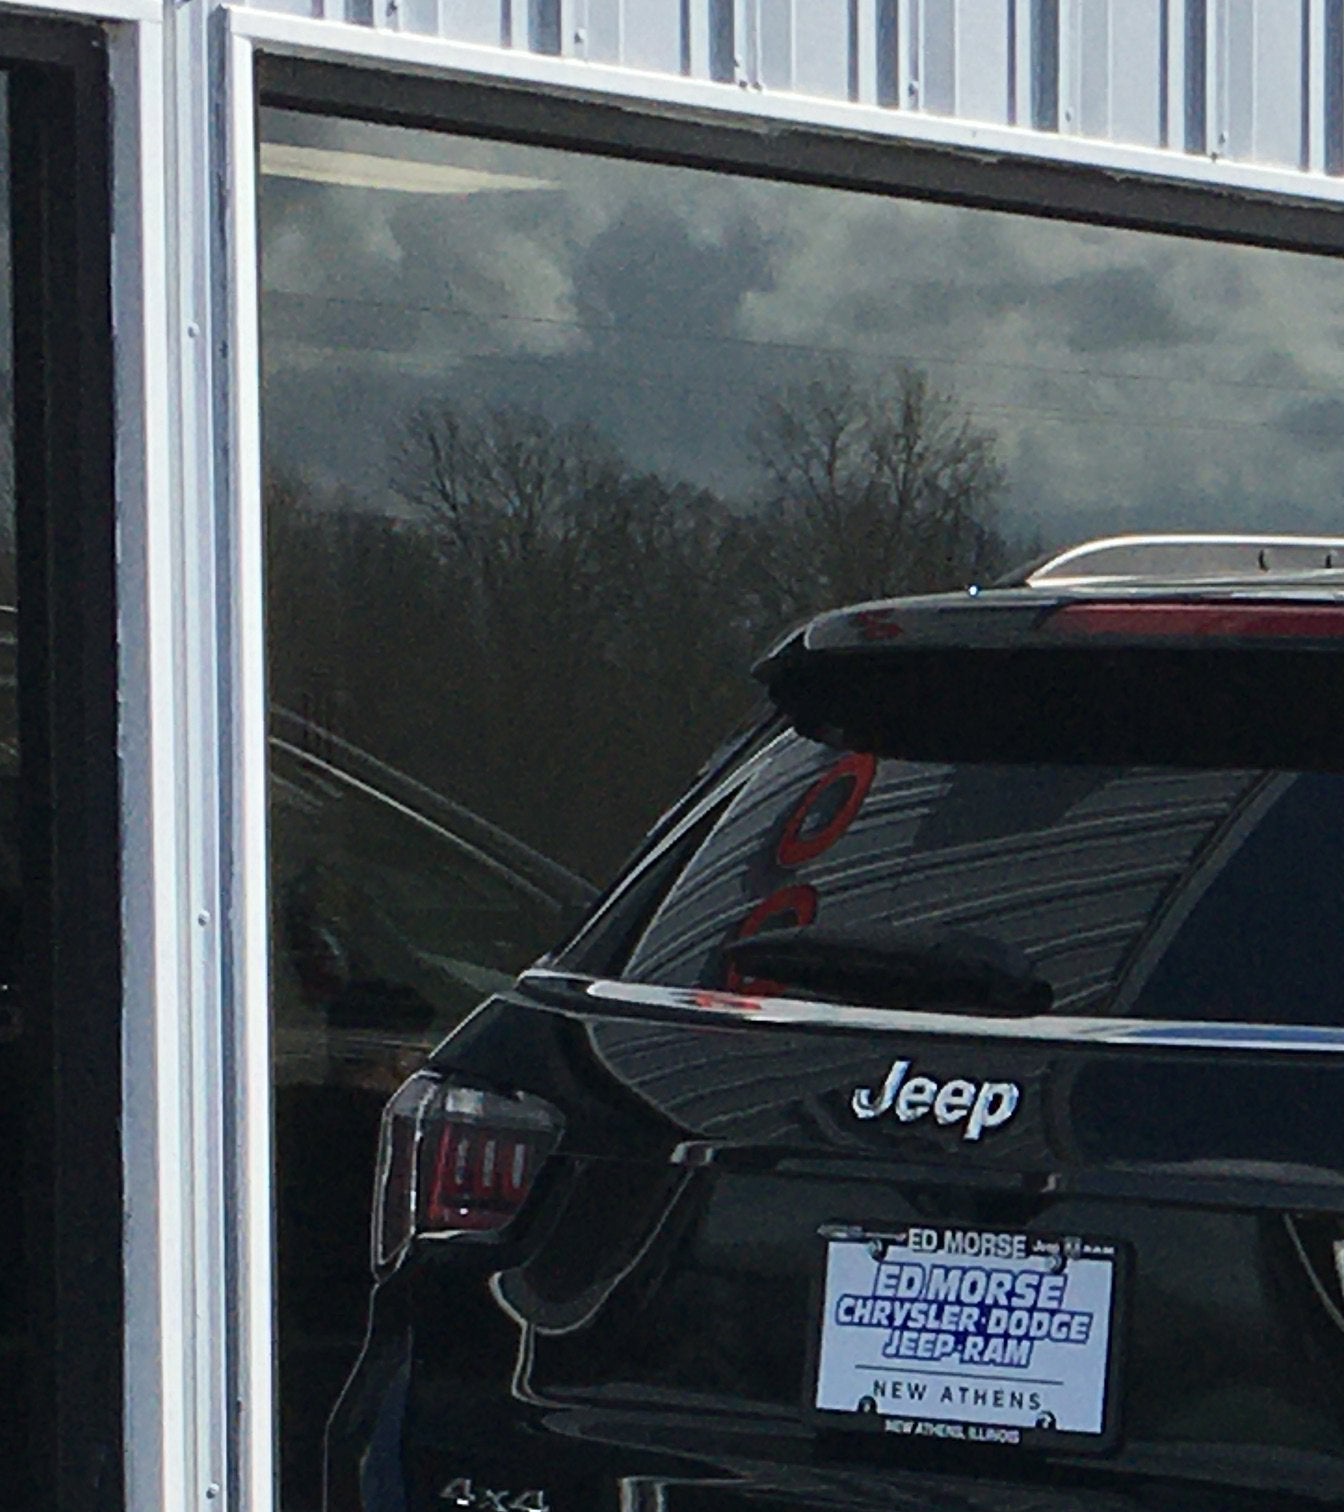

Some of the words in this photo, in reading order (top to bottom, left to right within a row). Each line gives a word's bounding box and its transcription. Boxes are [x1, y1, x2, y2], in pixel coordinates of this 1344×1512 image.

[852, 1060, 1019, 1140] Jeep
[908, 1228, 938, 1251] ED
[943, 1230, 1027, 1258] MORSE
[873, 1260, 926, 1299] ED
[927, 1264, 1067, 1309] MORSE
[872, 1379, 928, 1401] NEW
[940, 1386, 1042, 1411] ATHENS
